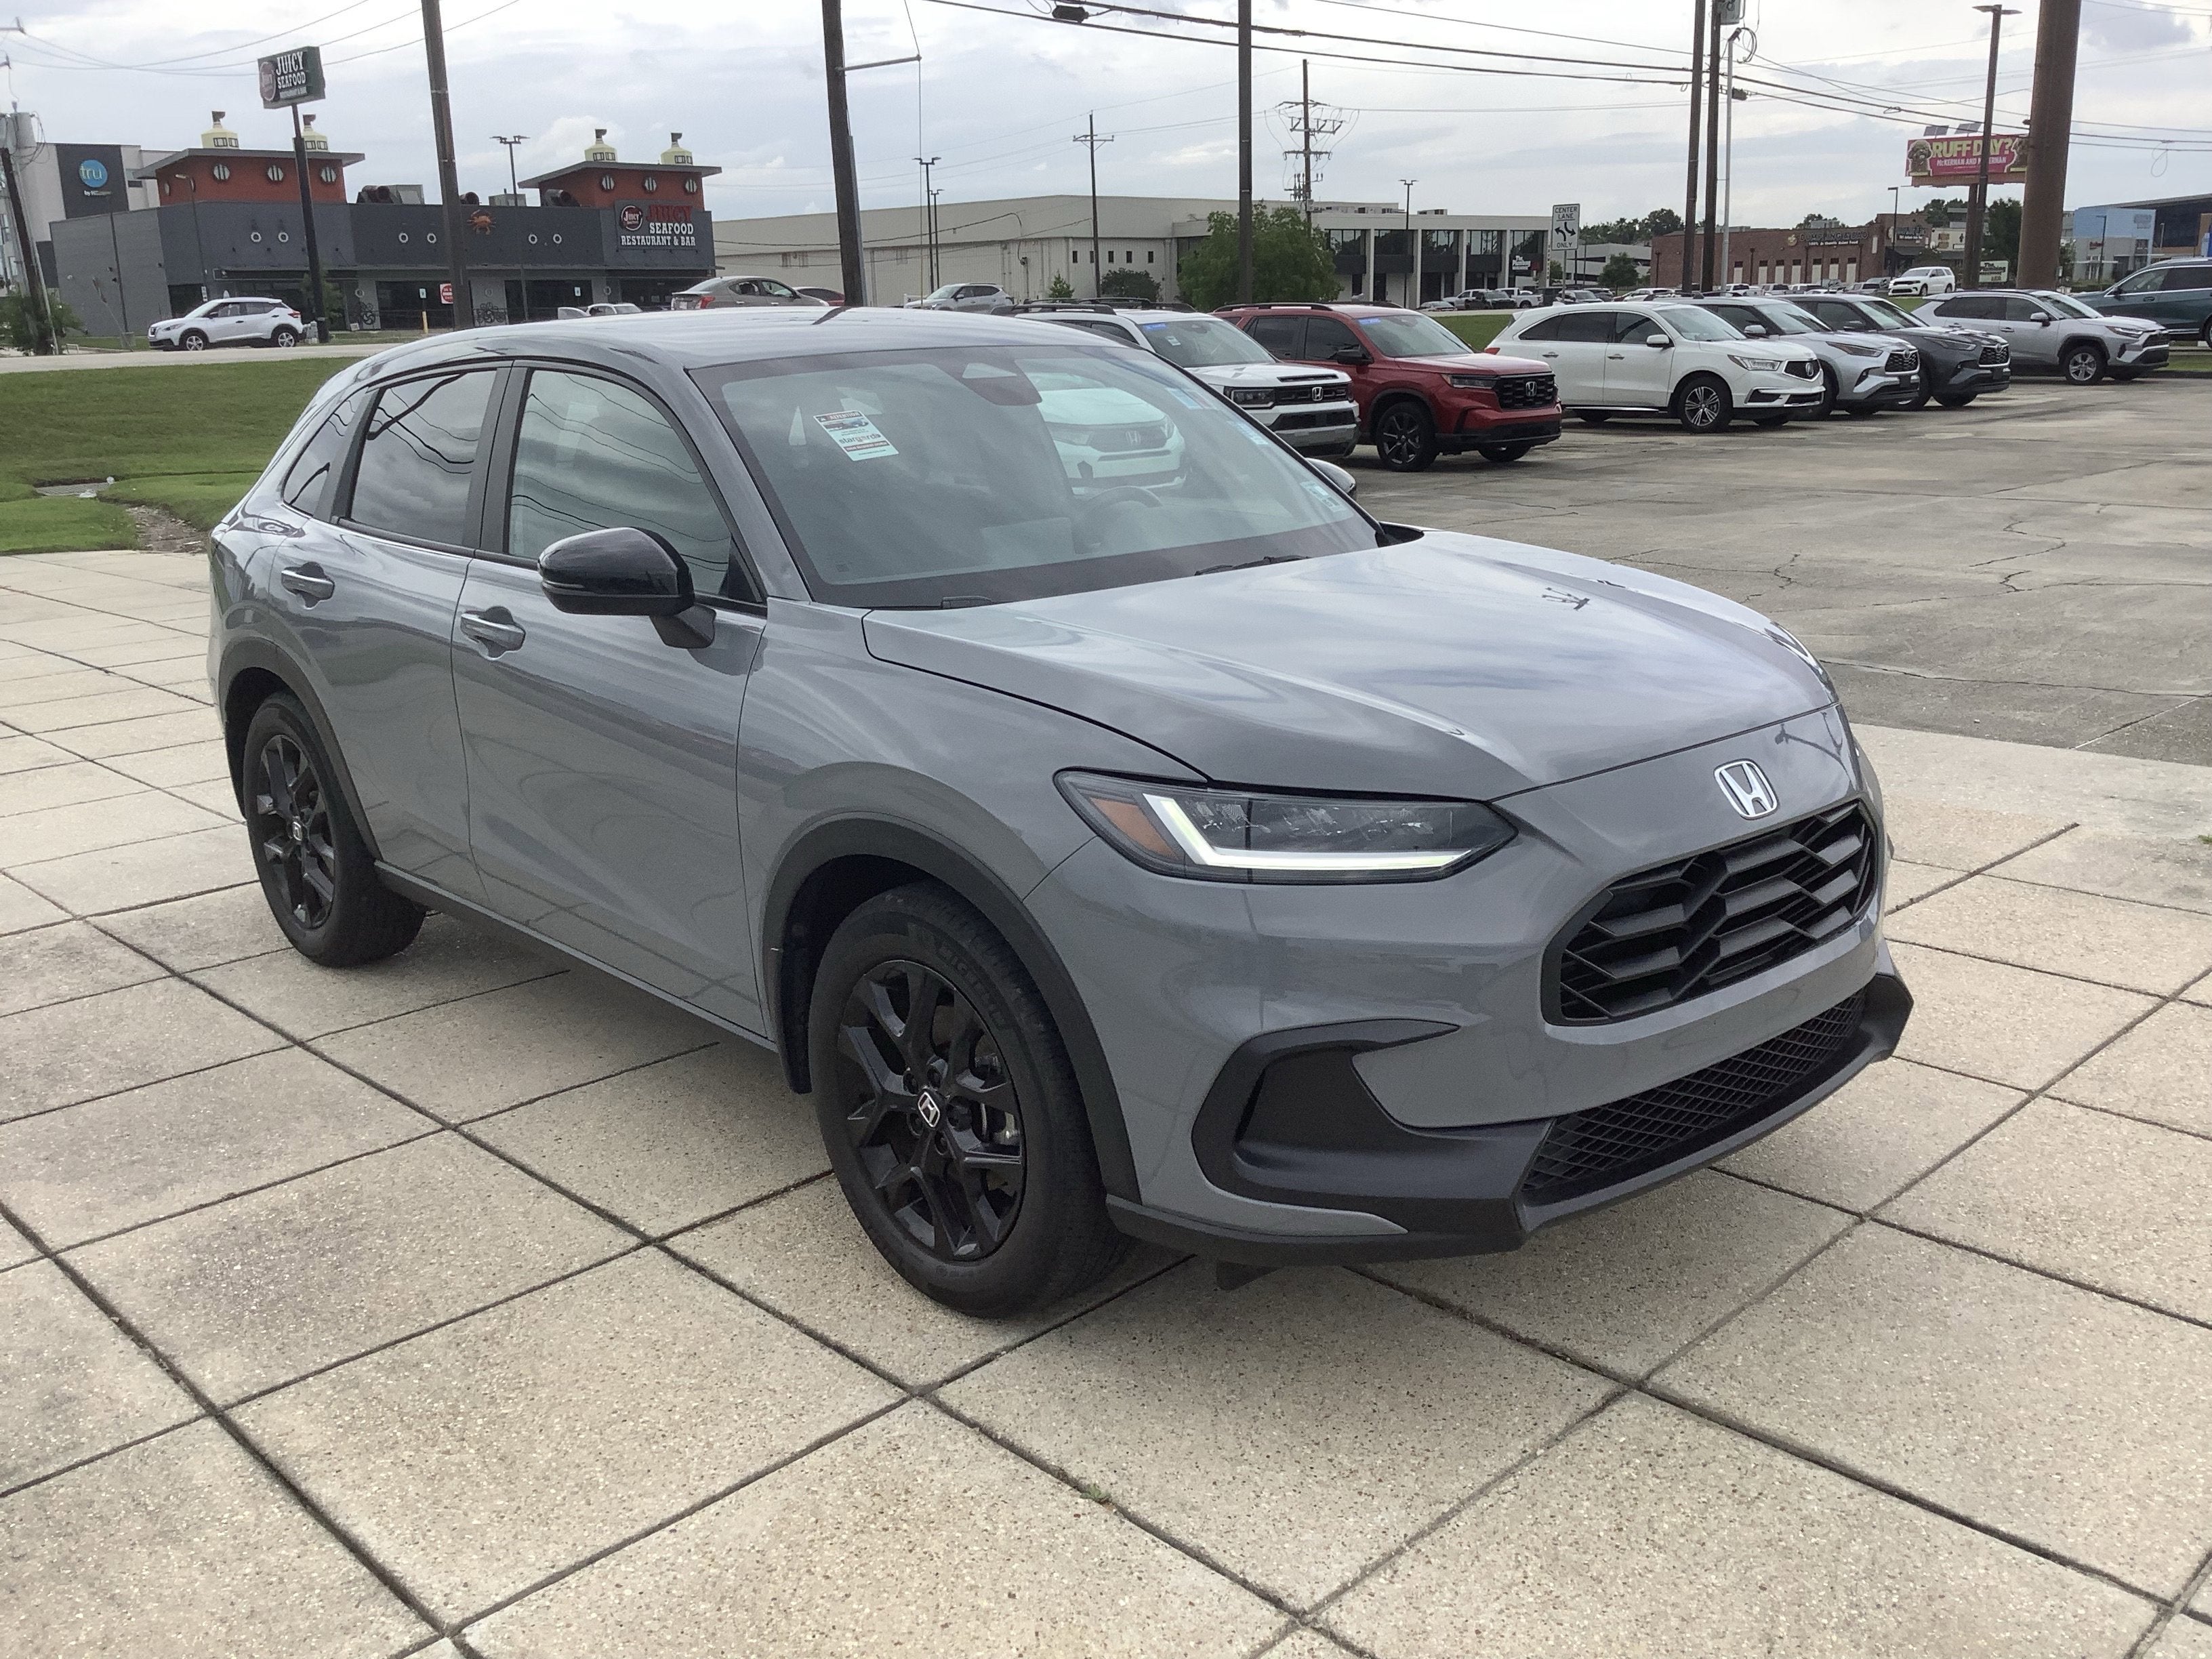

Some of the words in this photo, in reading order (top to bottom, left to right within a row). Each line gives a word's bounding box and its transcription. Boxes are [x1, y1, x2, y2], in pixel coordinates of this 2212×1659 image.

[276, 52, 303, 75] JUICY
[277, 71, 306, 89] SEAFOOD
[1931, 140, 1972, 158] RUFF
[80, 163, 102, 180] tru
[646, 205, 693, 222] JUICY
[649, 222, 694, 234] SEAFOOD
[621, 235, 671, 245] RESTAURANT
[673, 236, 678, 245] &
[680, 236, 696, 246] BAR
[829, 411, 861, 420] ATTENTION
